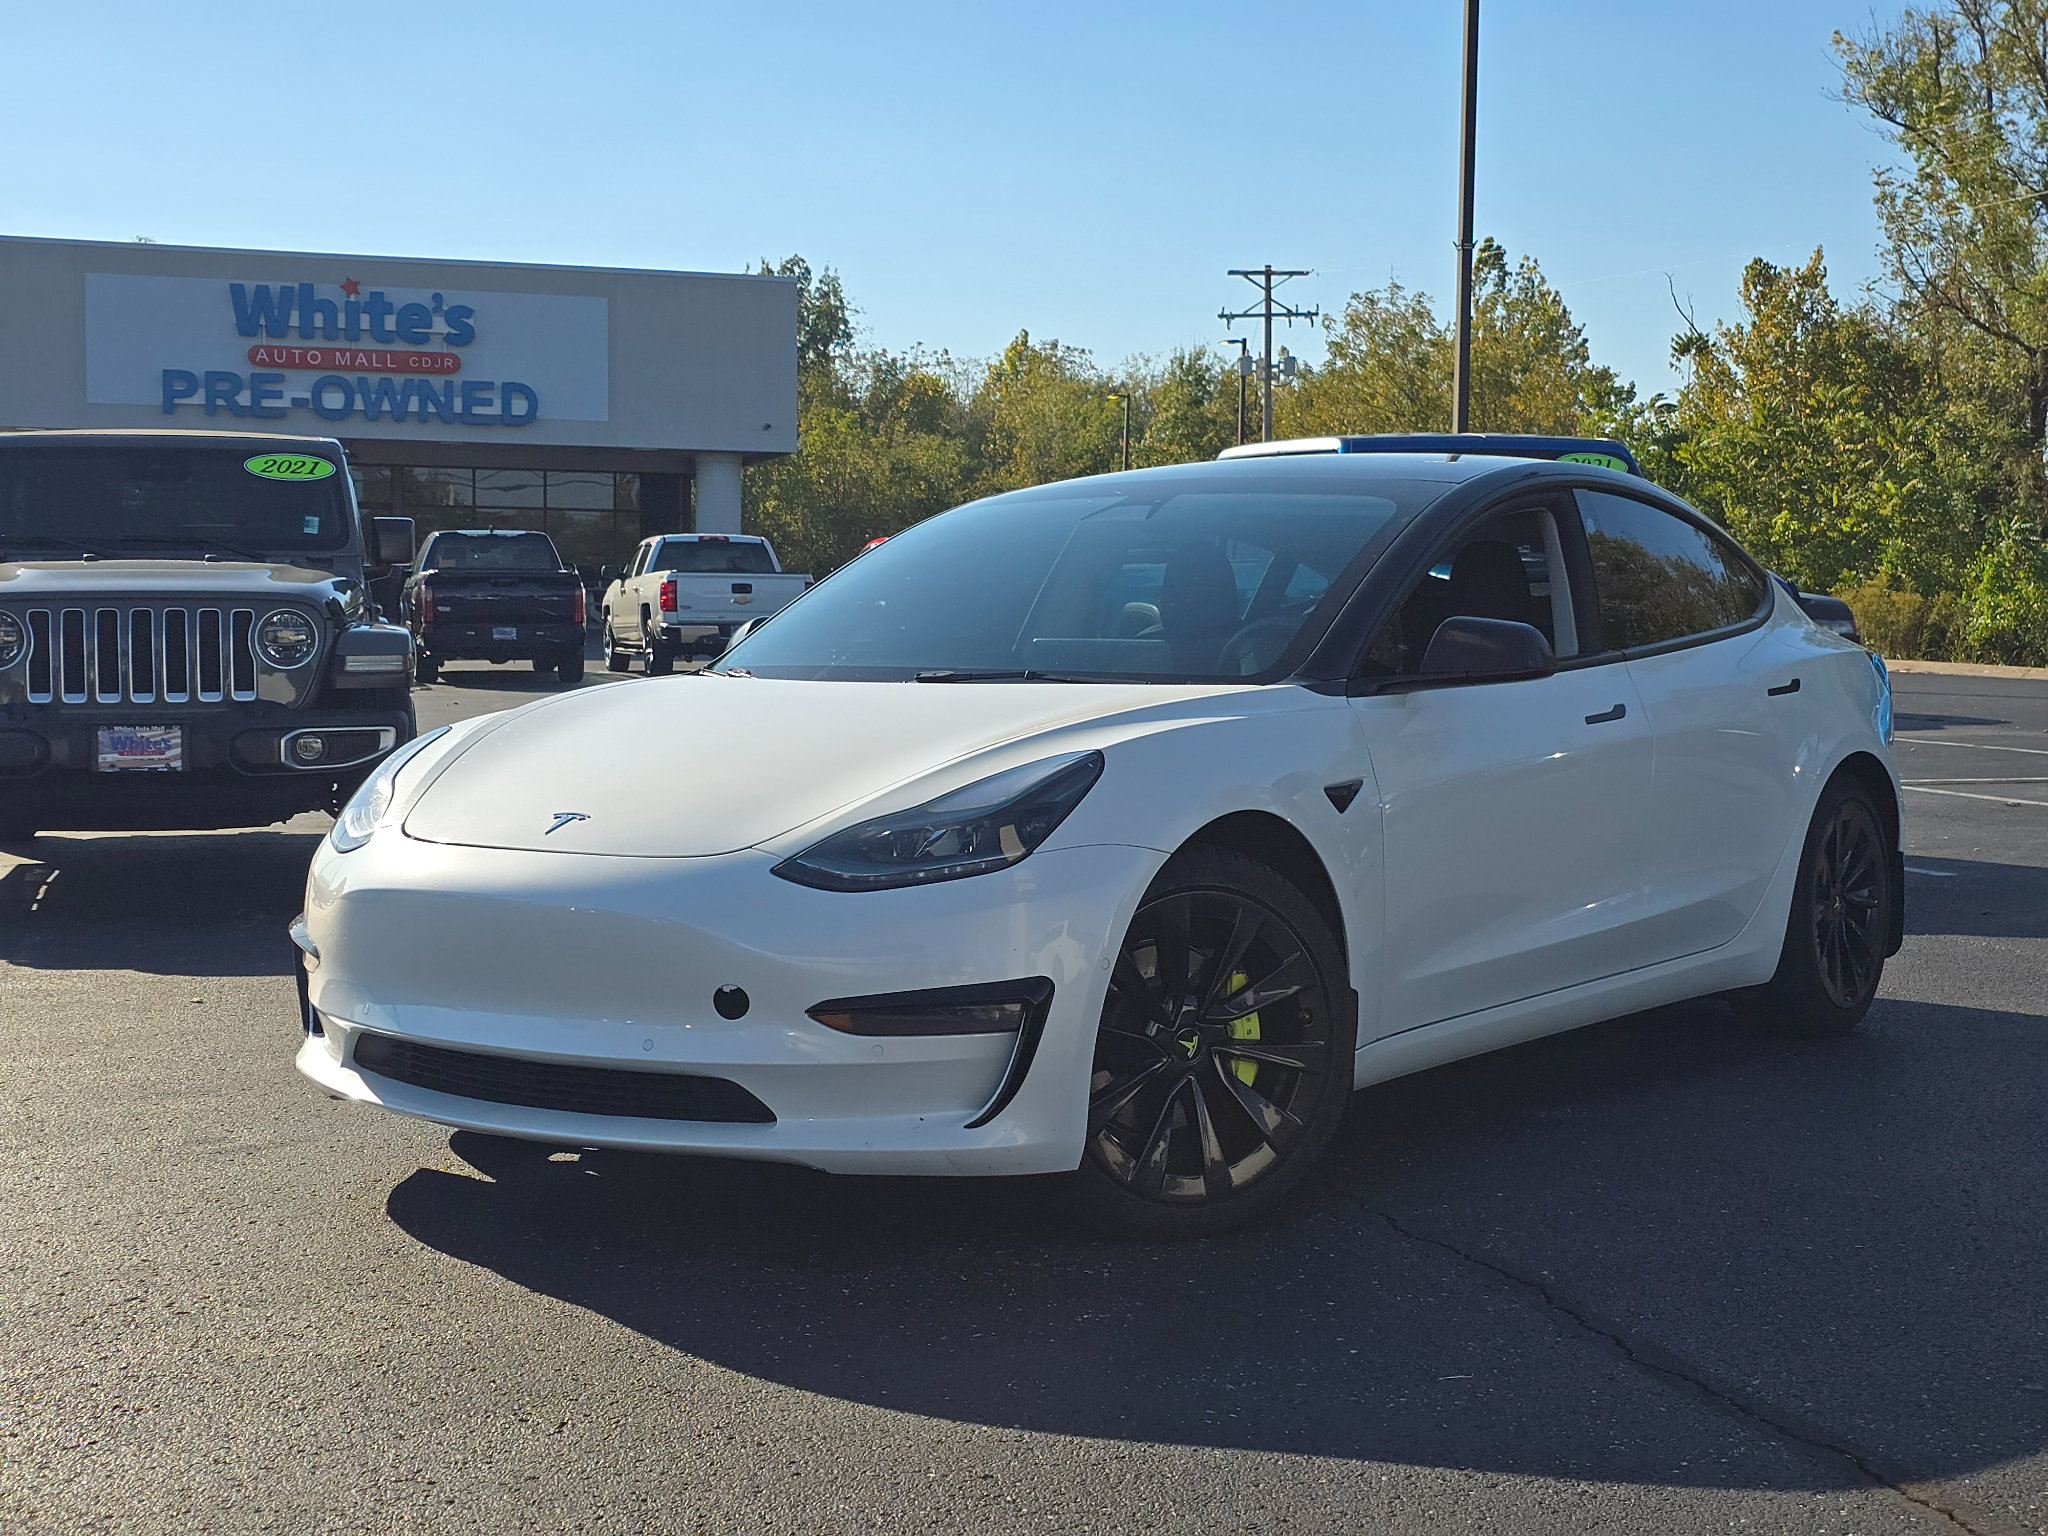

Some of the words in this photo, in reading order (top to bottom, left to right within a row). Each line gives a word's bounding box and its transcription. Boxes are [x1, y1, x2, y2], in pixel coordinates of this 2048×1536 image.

[229, 282, 476, 347] White's
[256, 348, 322, 365] AUTO
[335, 352, 398, 368] MALL
[409, 356, 455, 370] CDJR
[161, 369, 540, 427] PRE-OWNED
[260, 459, 320, 475] 2021
[109, 735, 172, 750] White's
